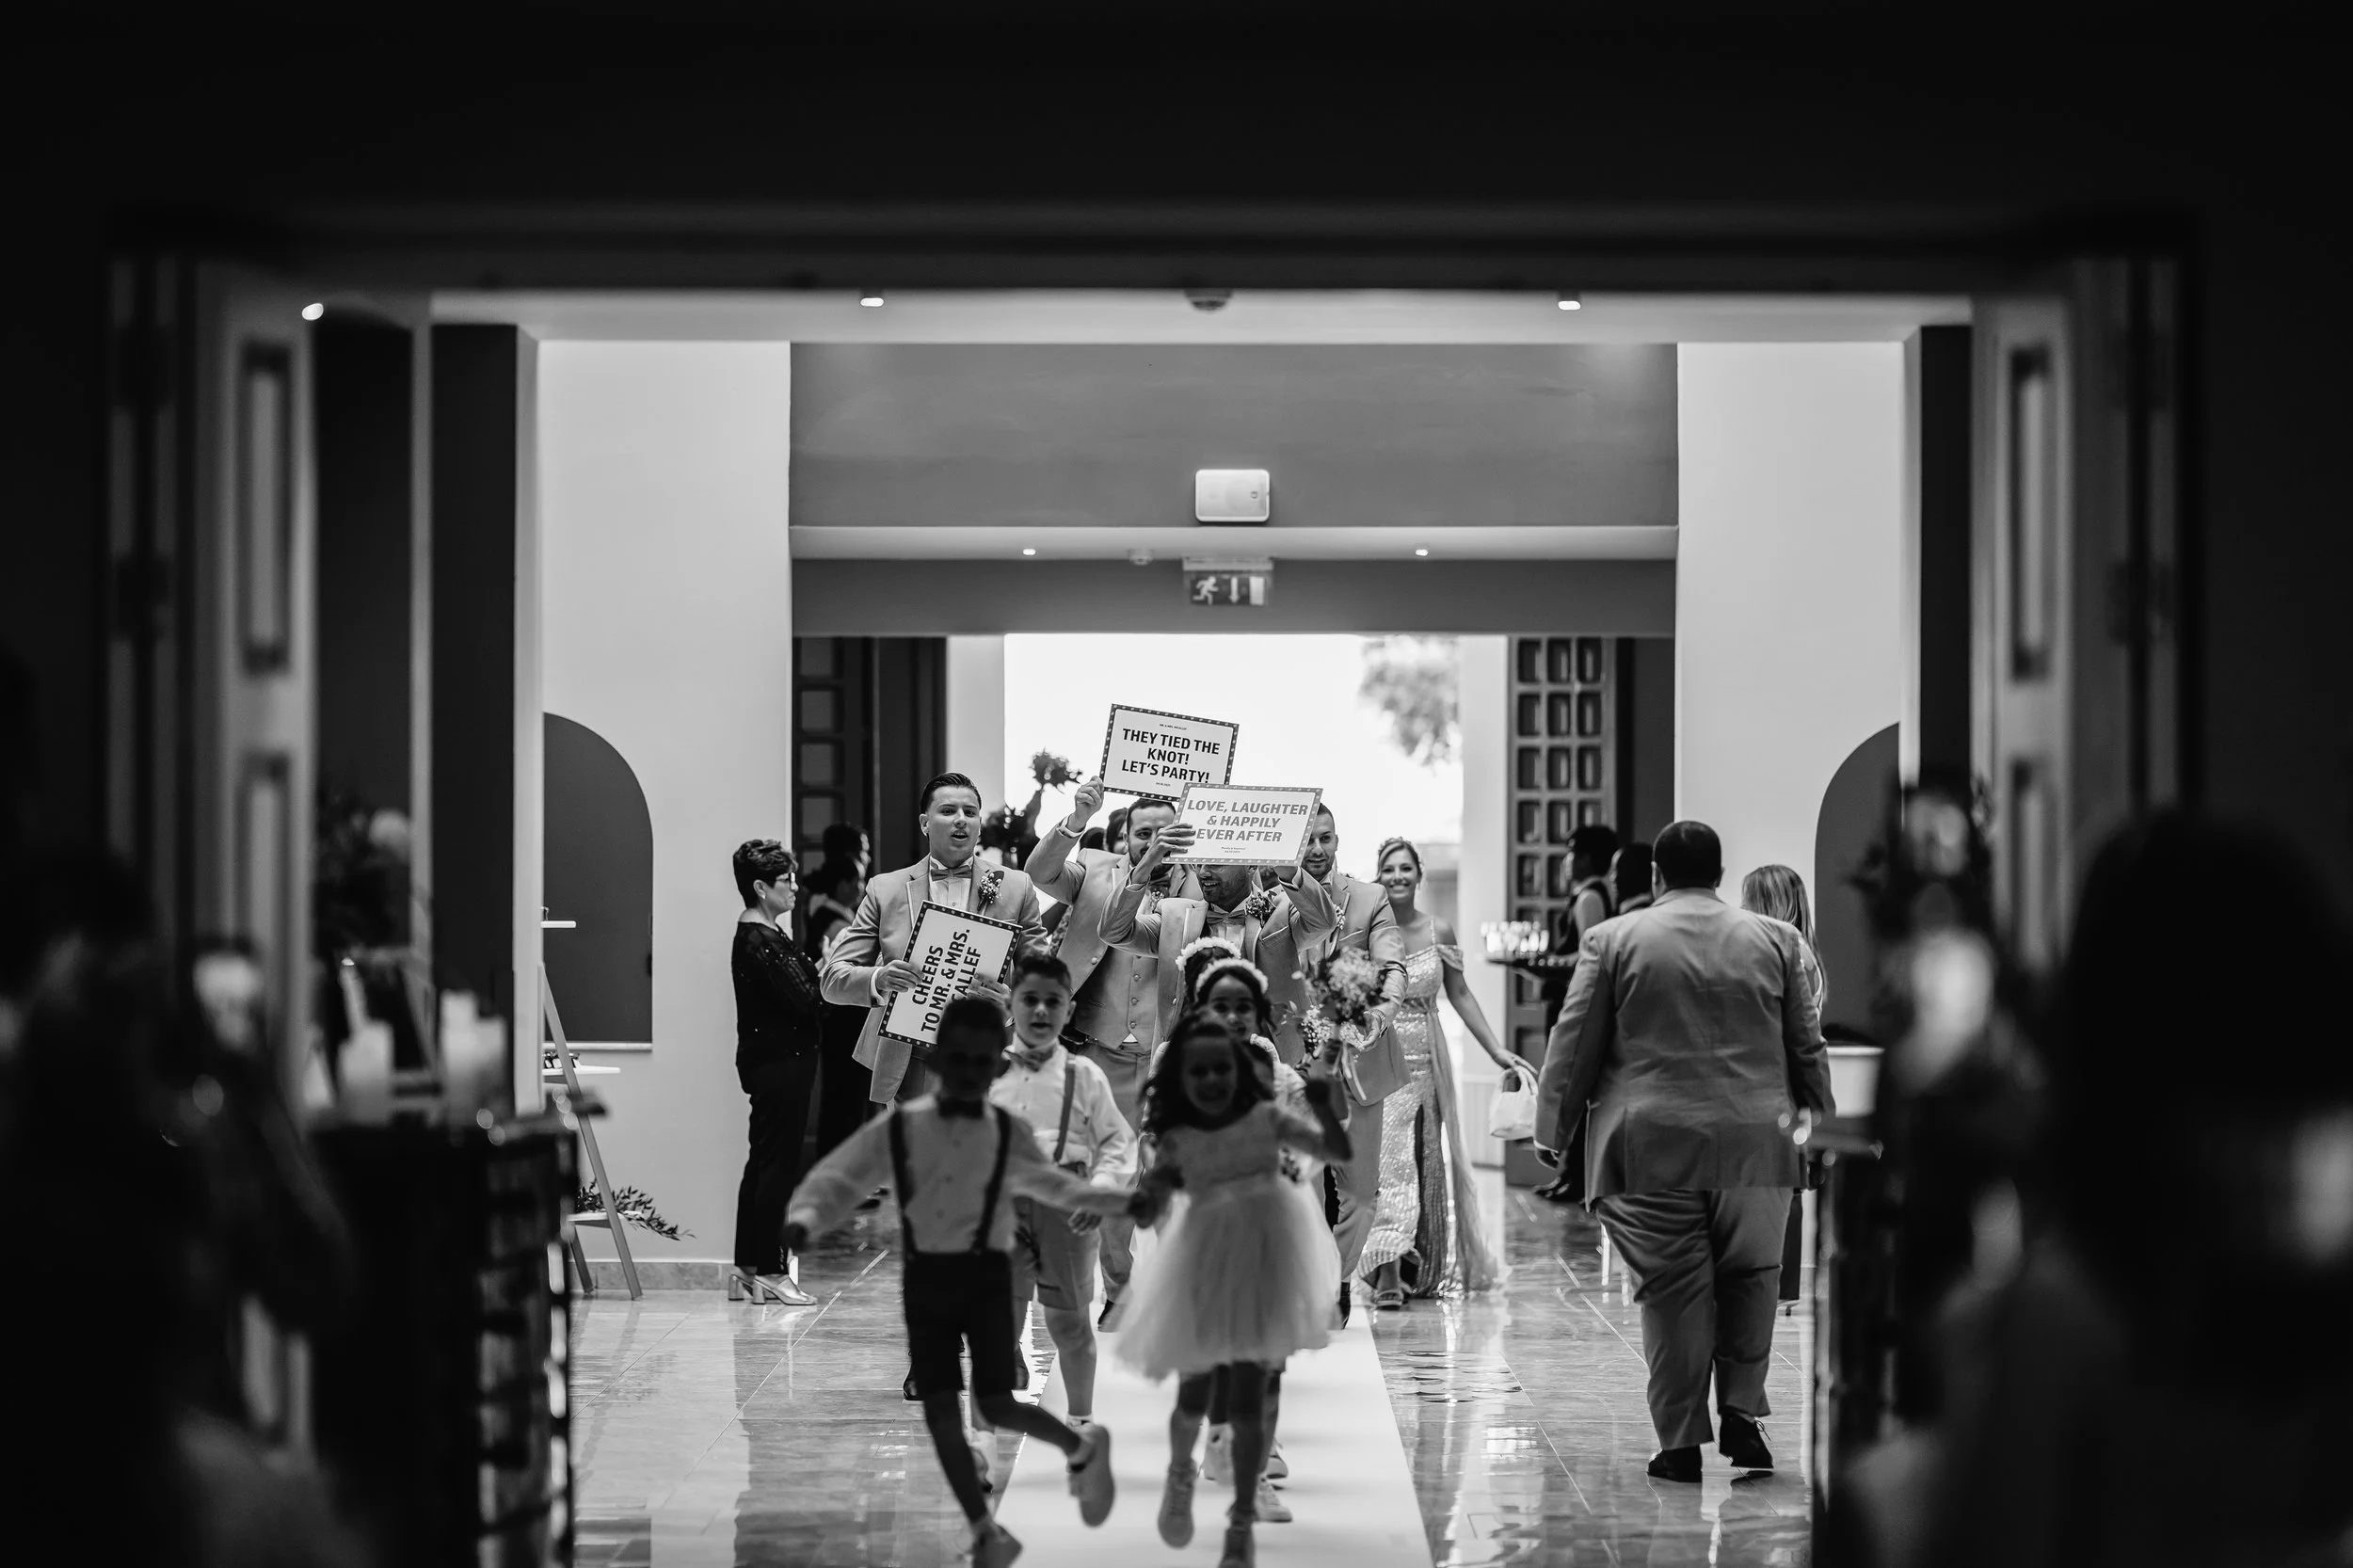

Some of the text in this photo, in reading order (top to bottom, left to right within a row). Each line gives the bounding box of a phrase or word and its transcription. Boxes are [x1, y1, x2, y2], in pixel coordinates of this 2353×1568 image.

[1123, 728, 1221, 755] THEY TIED THE
[1147, 747, 1190, 765] KNOT!
[1122, 760, 1209, 784] LET'S PARTY!
[1187, 800, 1309, 815] LOVE, LAUGHTER
[1207, 815, 1281, 828] & HAPPILY
[1196, 828, 1282, 842] EVER AFTER
[912, 945, 944, 1006] CHEERS
[920, 929, 970, 1032] TO MR. & MRS.
